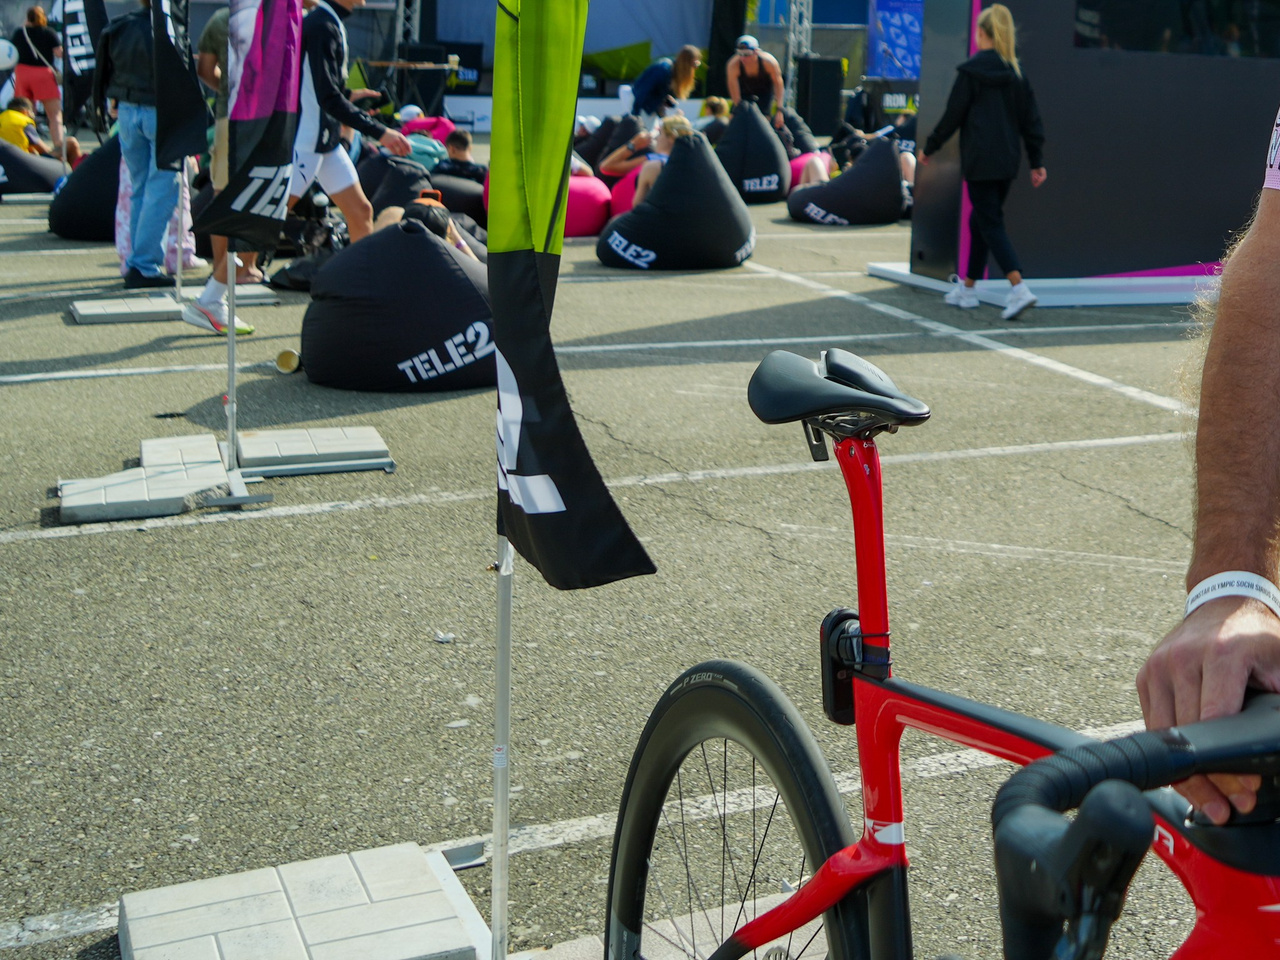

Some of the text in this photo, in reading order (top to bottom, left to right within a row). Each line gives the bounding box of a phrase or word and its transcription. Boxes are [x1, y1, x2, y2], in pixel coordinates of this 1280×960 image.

[742, 173, 780, 191] TELE2
[607, 230, 658, 269] TELE2
[396, 320, 496, 384] TELE2
[1210, 581, 1236, 592] OLYMPIC
[1236, 580, 1255, 590] SOCHI
[683, 676, 690, 688] P
[690, 672, 713, 684] ZERO
